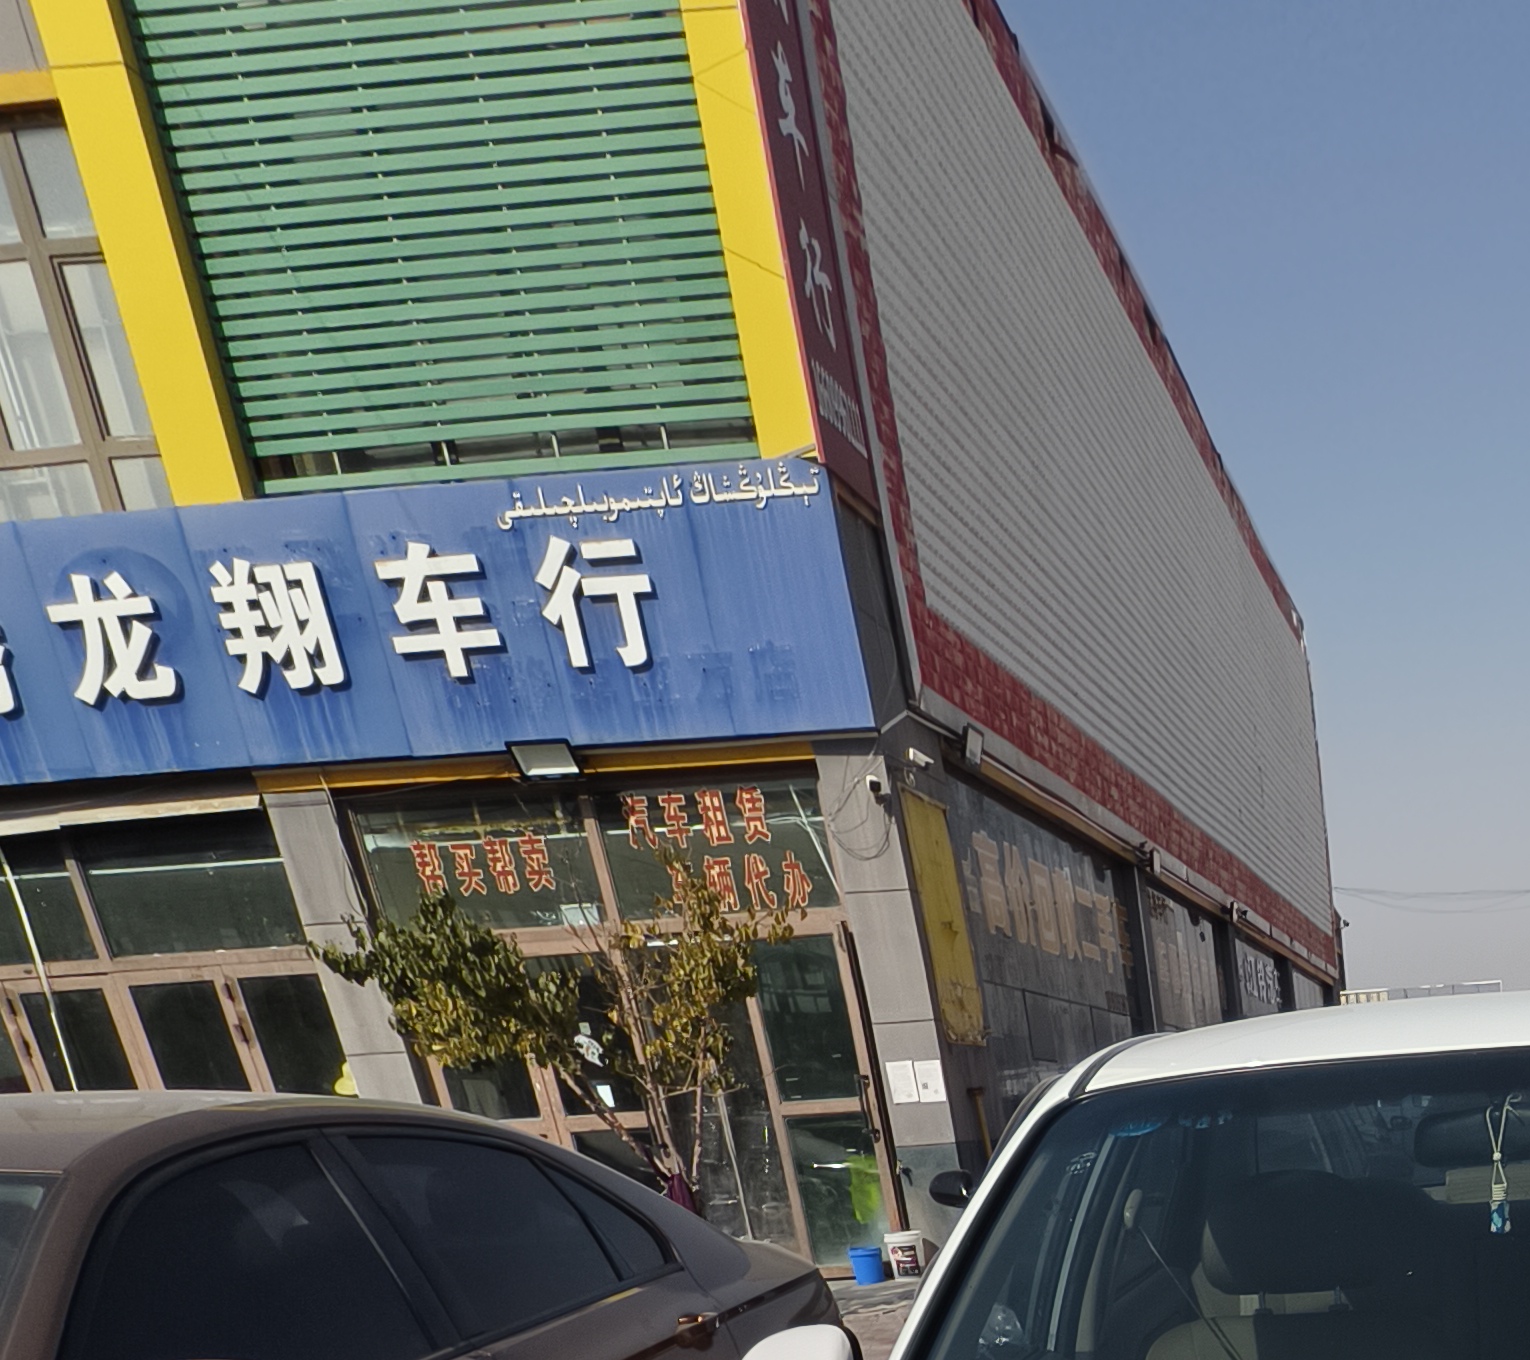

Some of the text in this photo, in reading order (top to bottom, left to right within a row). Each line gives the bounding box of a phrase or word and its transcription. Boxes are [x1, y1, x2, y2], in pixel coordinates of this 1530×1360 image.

[0, 536, 652, 714] 龙翔车行
[620, 785, 772, 850] 汽车租赁
[409, 833, 557, 896] 帮买帮卖
